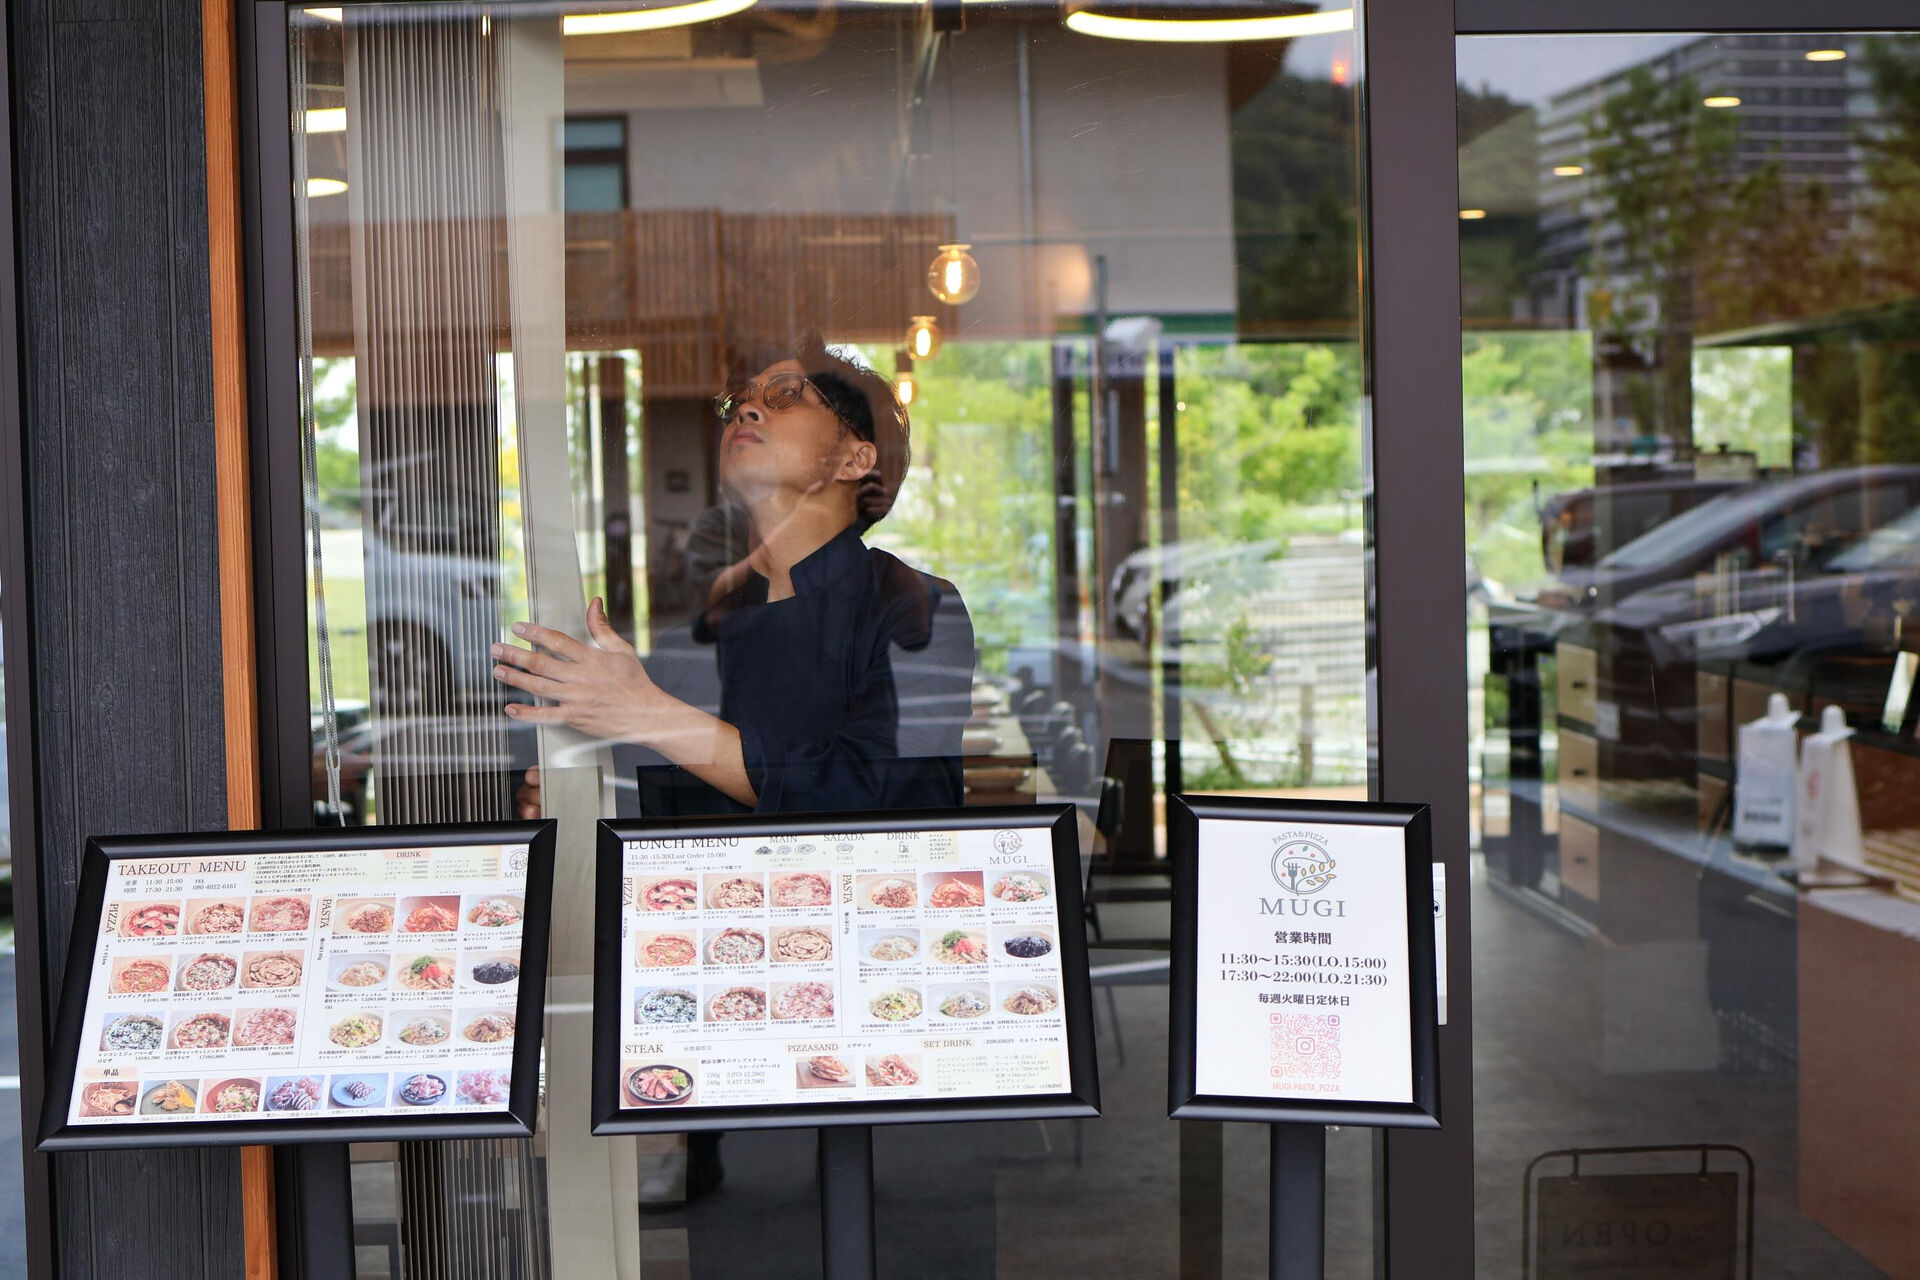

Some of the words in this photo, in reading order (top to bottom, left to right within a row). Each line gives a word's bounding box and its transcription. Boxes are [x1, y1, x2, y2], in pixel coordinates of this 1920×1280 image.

[628, 838, 684, 850] LUNCH
[692, 837, 739, 848] MENU
[1272, 830, 1329, 847] PASTA&PIZZA
[989, 855, 1027, 865] MUGI
[117, 862, 190, 876] TAKEOUT
[198, 861, 247, 873] MENU
[842, 874, 853, 904] PASTA
[319, 899, 332, 929] PASTA
[1258, 898, 1346, 917] MUGI
[105, 904, 120, 934] PIZZA
[1274, 931, 1332, 945] 営業時間
[1258, 993, 1350, 1006] 毎週火曜日定休日
[624, 1045, 664, 1053] STEAK
[787, 1043, 839, 1052] PIZZASAND
[923, 1040, 940, 1048] SET
[942, 1039, 972, 1047] DRINK
